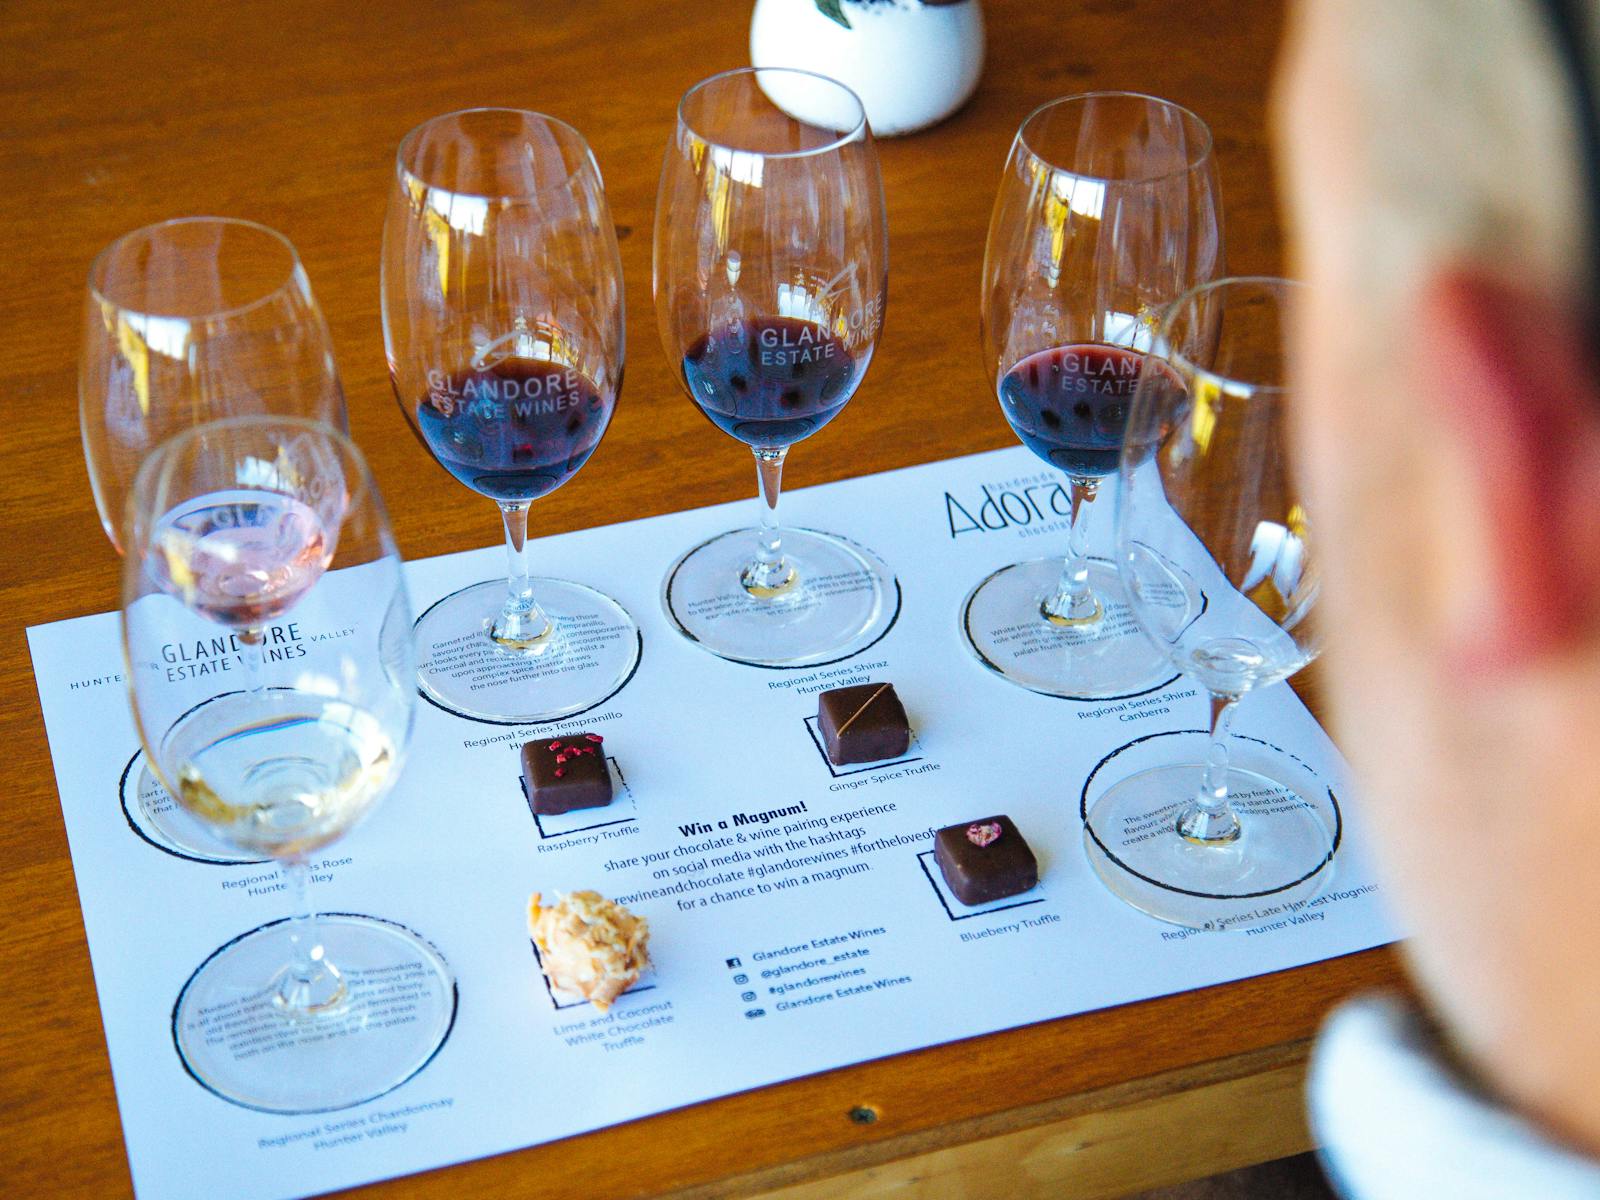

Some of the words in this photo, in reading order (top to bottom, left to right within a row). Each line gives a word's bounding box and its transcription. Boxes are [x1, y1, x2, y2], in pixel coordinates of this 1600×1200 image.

[761, 342, 835, 366] ESTATE
[1062, 352, 1137, 376] GLAN
[427, 367, 578, 400] GLANDORE
[515, 391, 580, 417] WINES
[310, 628, 356, 643] VALLEY
[167, 657, 232, 683] ESTATE
[768, 673, 819, 690] Regional
[820, 667, 853, 680] Series
[854, 659, 889, 672] Shiraz
[797, 682, 836, 695] Hunter
[836, 675, 871, 687] Valley
[1077, 703, 1127, 720] Regional
[1128, 697, 1162, 710] Series
[1163, 689, 1198, 702] Shiraz
[1119, 707, 1170, 722] Canberra
[463, 732, 515, 749] Regional
[517, 725, 553, 737] Series
[553, 711, 623, 730] Tempranillo
[829, 776, 868, 793] Ginger
[870, 770, 902, 785] Spice
[902, 762, 941, 777] Truffle
[678, 822, 713, 838] Win
[718, 819, 728, 829] a
[732, 800, 809, 827] Magnum!
[537, 834, 600, 855] Raspberry
[600, 825, 641, 840] Truffle
[604, 857, 639, 873] share
[641, 850, 671, 867] your
[673, 836, 734, 857] chocolate
[736, 832, 747, 843] &
[748, 826, 781, 842] wine
[783, 816, 829, 836] pairing
[830, 801, 897, 824] experience
[652, 868, 670, 880] on
[672, 857, 708, 876] social
[711, 850, 752, 868] media
[753, 843, 783, 859] with
[785, 838, 808, 851] the
[808, 825, 867, 847] hashtags
[221, 870, 279, 890] Regional
[322, 856, 353, 869] Rose
[613, 869, 745, 906] rewineandchocolate
[747, 848, 849, 879] #glandorewines
[850, 827, 937, 856] #fortheloveof
[677, 898, 697, 912] for
[700, 896, 708, 907] a
[710, 886, 756, 905] chance
[757, 882, 772, 894] to
[773, 875, 799, 891] win
[802, 874, 810, 885] a
[811, 861, 875, 883] magnum.
[960, 923, 1021, 943] Blueberry
[1020, 914, 1062, 929] Truffle
[1217, 913, 1255, 928] Series
[1254, 906, 1281, 919] Late
[1288, 911, 1326, 926] Valley
[753, 942, 810, 962] Glandore
[811, 934, 848, 949] Estate
[848, 925, 887, 941] Wines
[760, 947, 871, 979] @glandore_estate
[776, 992, 834, 1012] Glandore
[835, 984, 873, 998] Estate
[873, 974, 913, 990] Wines
[553, 1020, 586, 1037] Lime
[590, 1013, 614, 1027] and
[616, 1000, 674, 1021] Coconut
[564, 1031, 606, 1048] White
[607, 1014, 675, 1038] Chocolate
[601, 1034, 646, 1053] Truffle
